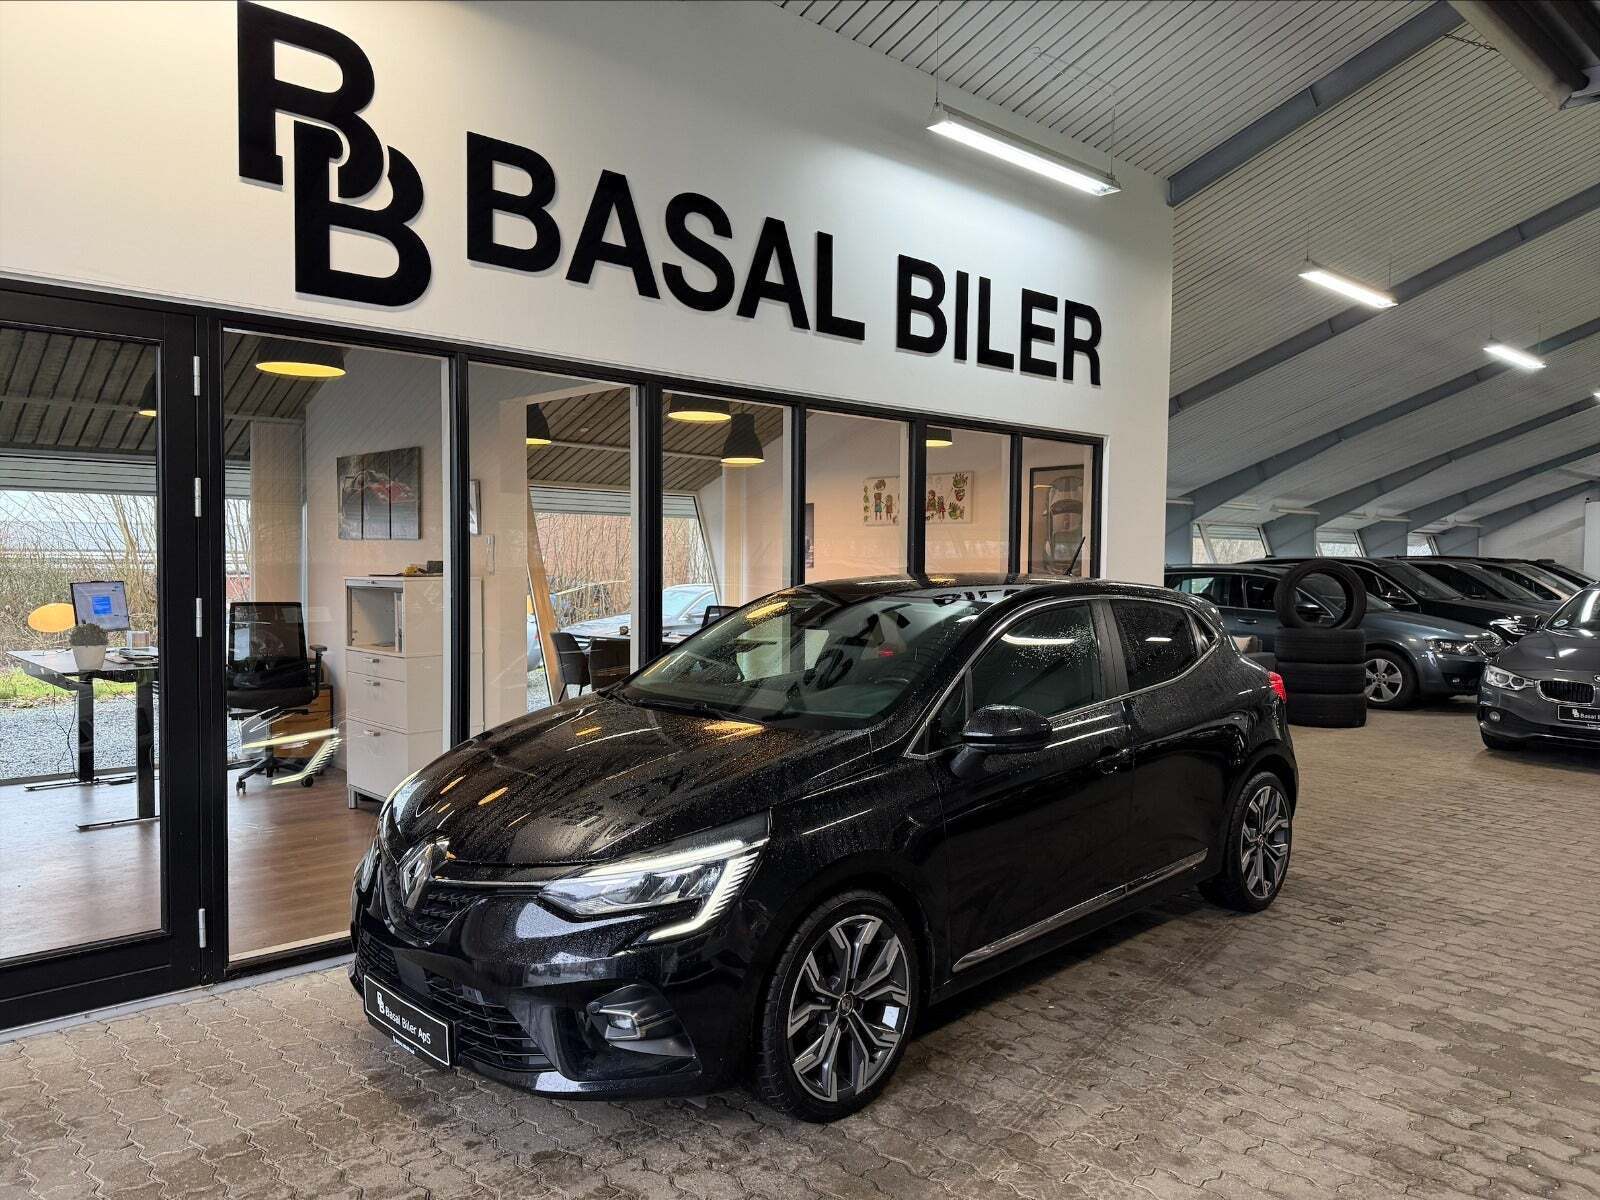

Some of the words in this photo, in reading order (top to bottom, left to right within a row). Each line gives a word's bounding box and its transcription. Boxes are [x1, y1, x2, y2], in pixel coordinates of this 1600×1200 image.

[466, 131, 866, 341] BASAL
[896, 253, 1102, 386] BILER
[385, 1005, 401, 1026] Basal
[401, 1016, 417, 1035] Biler
[417, 1027, 431, 1045] ApS
